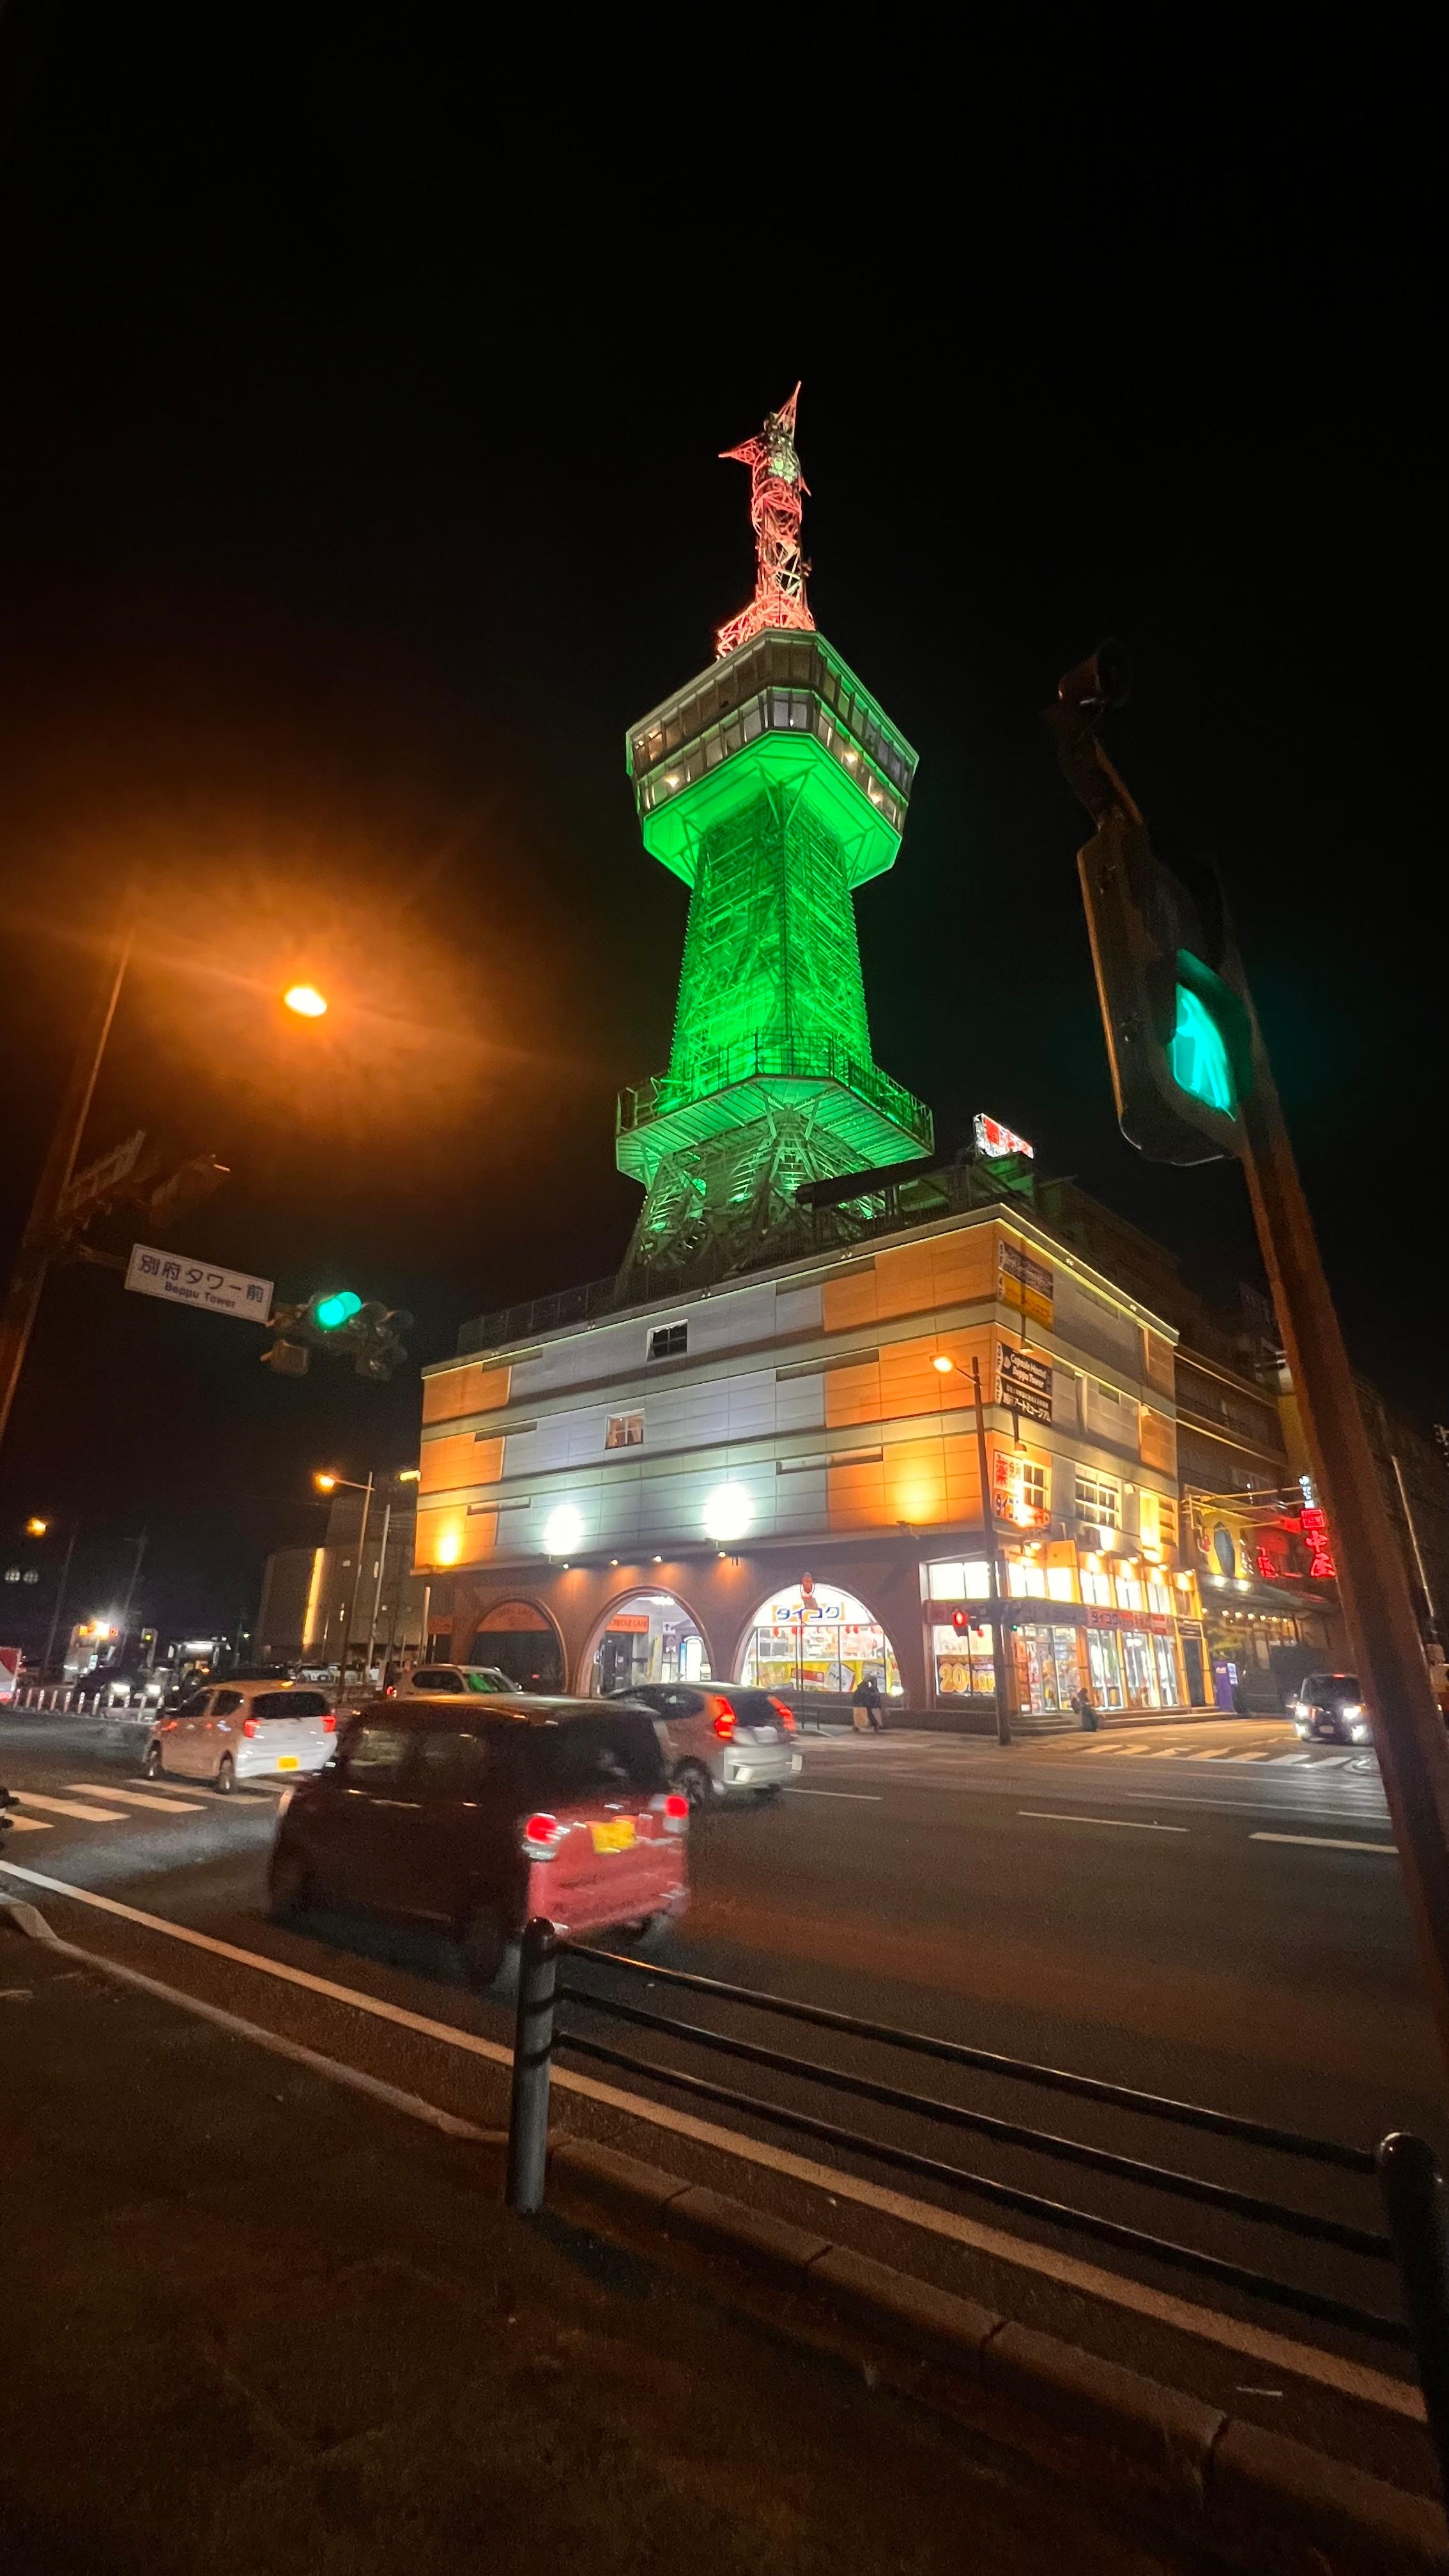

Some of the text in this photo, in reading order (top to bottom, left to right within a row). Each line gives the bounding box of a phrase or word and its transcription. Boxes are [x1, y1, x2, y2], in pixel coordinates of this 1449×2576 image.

[139, 1254, 264, 1303] 別府タワー前
[165, 1281, 236, 1309] Beppu Tower
